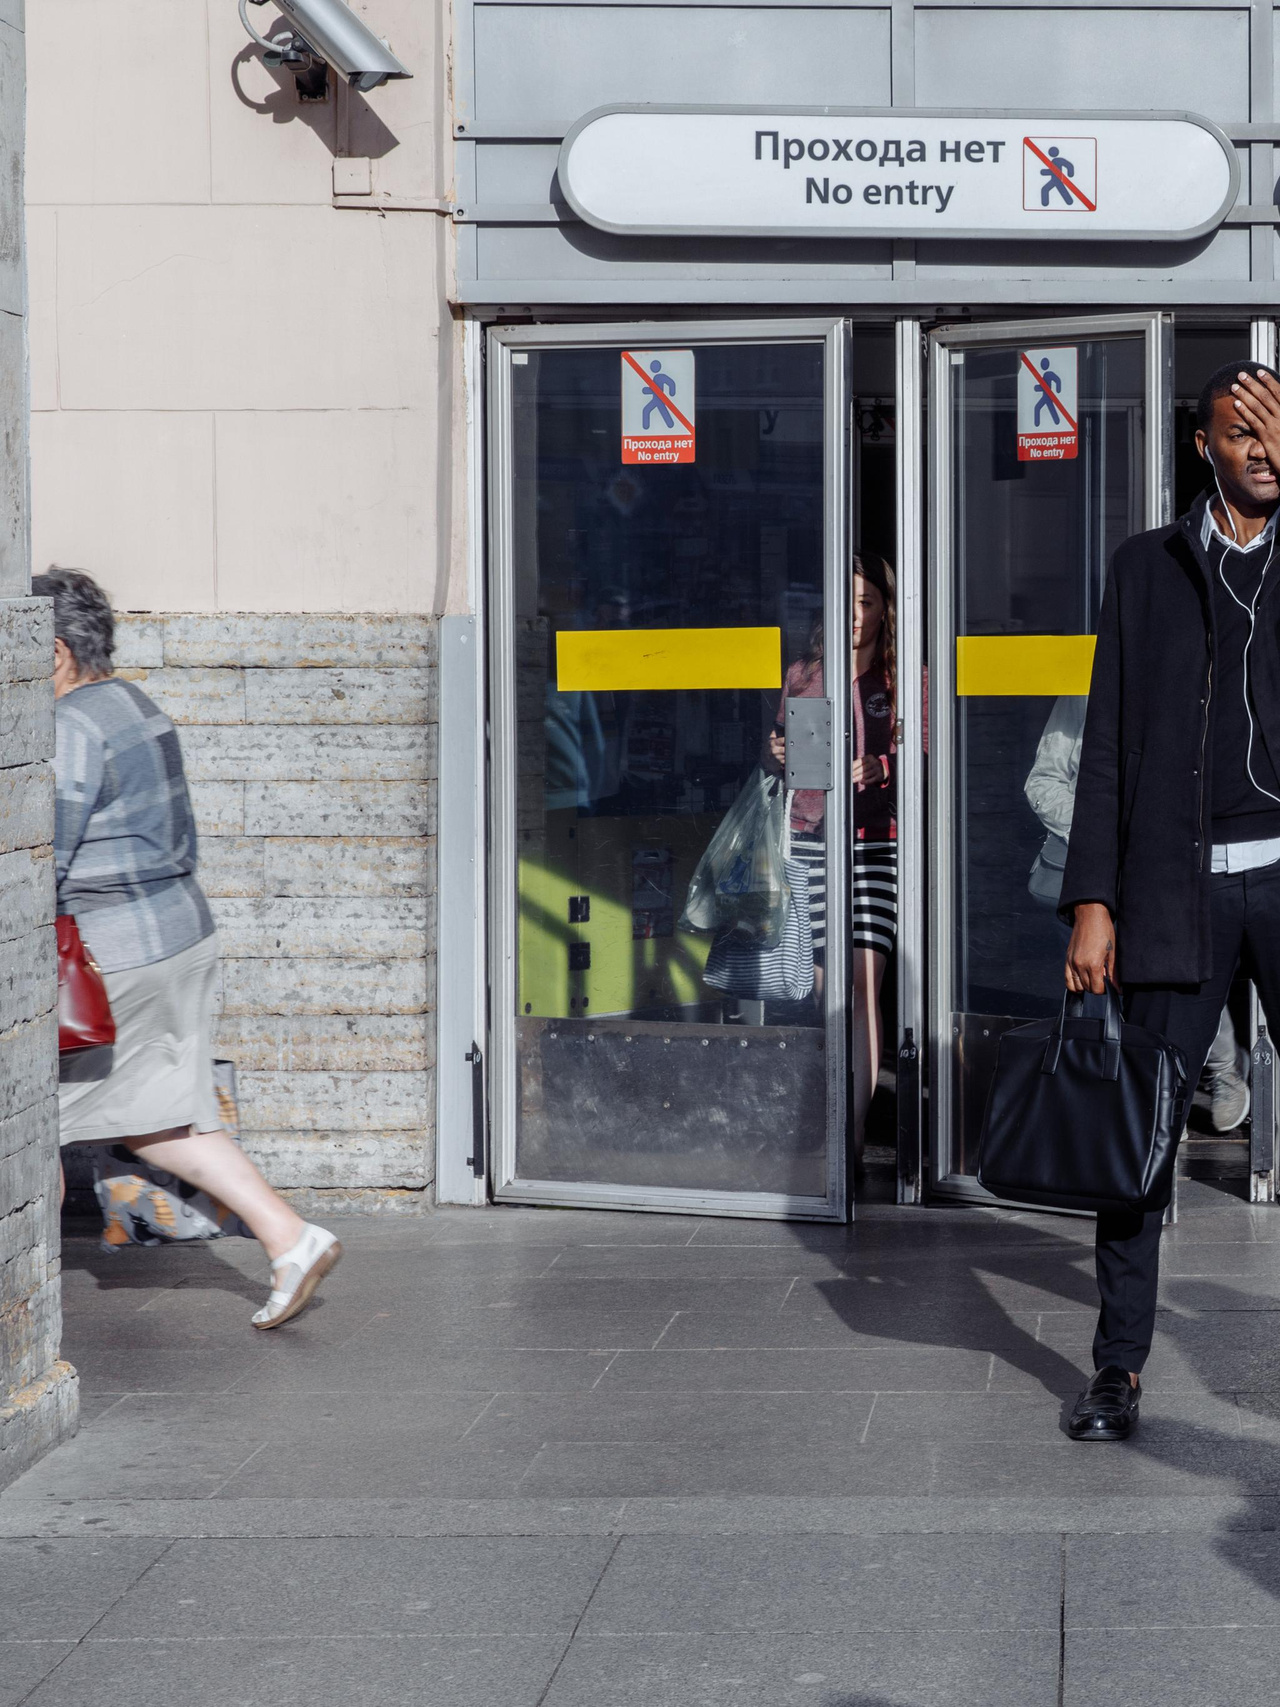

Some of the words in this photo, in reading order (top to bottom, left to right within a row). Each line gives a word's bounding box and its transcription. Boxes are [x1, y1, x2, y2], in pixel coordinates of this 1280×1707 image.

[755, 130, 927, 169] Прохода
[940, 140, 1006, 163] нет
[805, 177, 853, 205] No
[862, 180, 954, 213] entry
[624, 438, 672, 452] Прохода
[674, 439, 694, 448] нет
[1018, 436, 1058, 449] Прохода
[1060, 435, 1076, 444] нет
[637, 451, 652, 461] No
[653, 451, 680, 463] entry
[1030, 448, 1042, 458] No
[1043, 448, 1065, 459] entry
